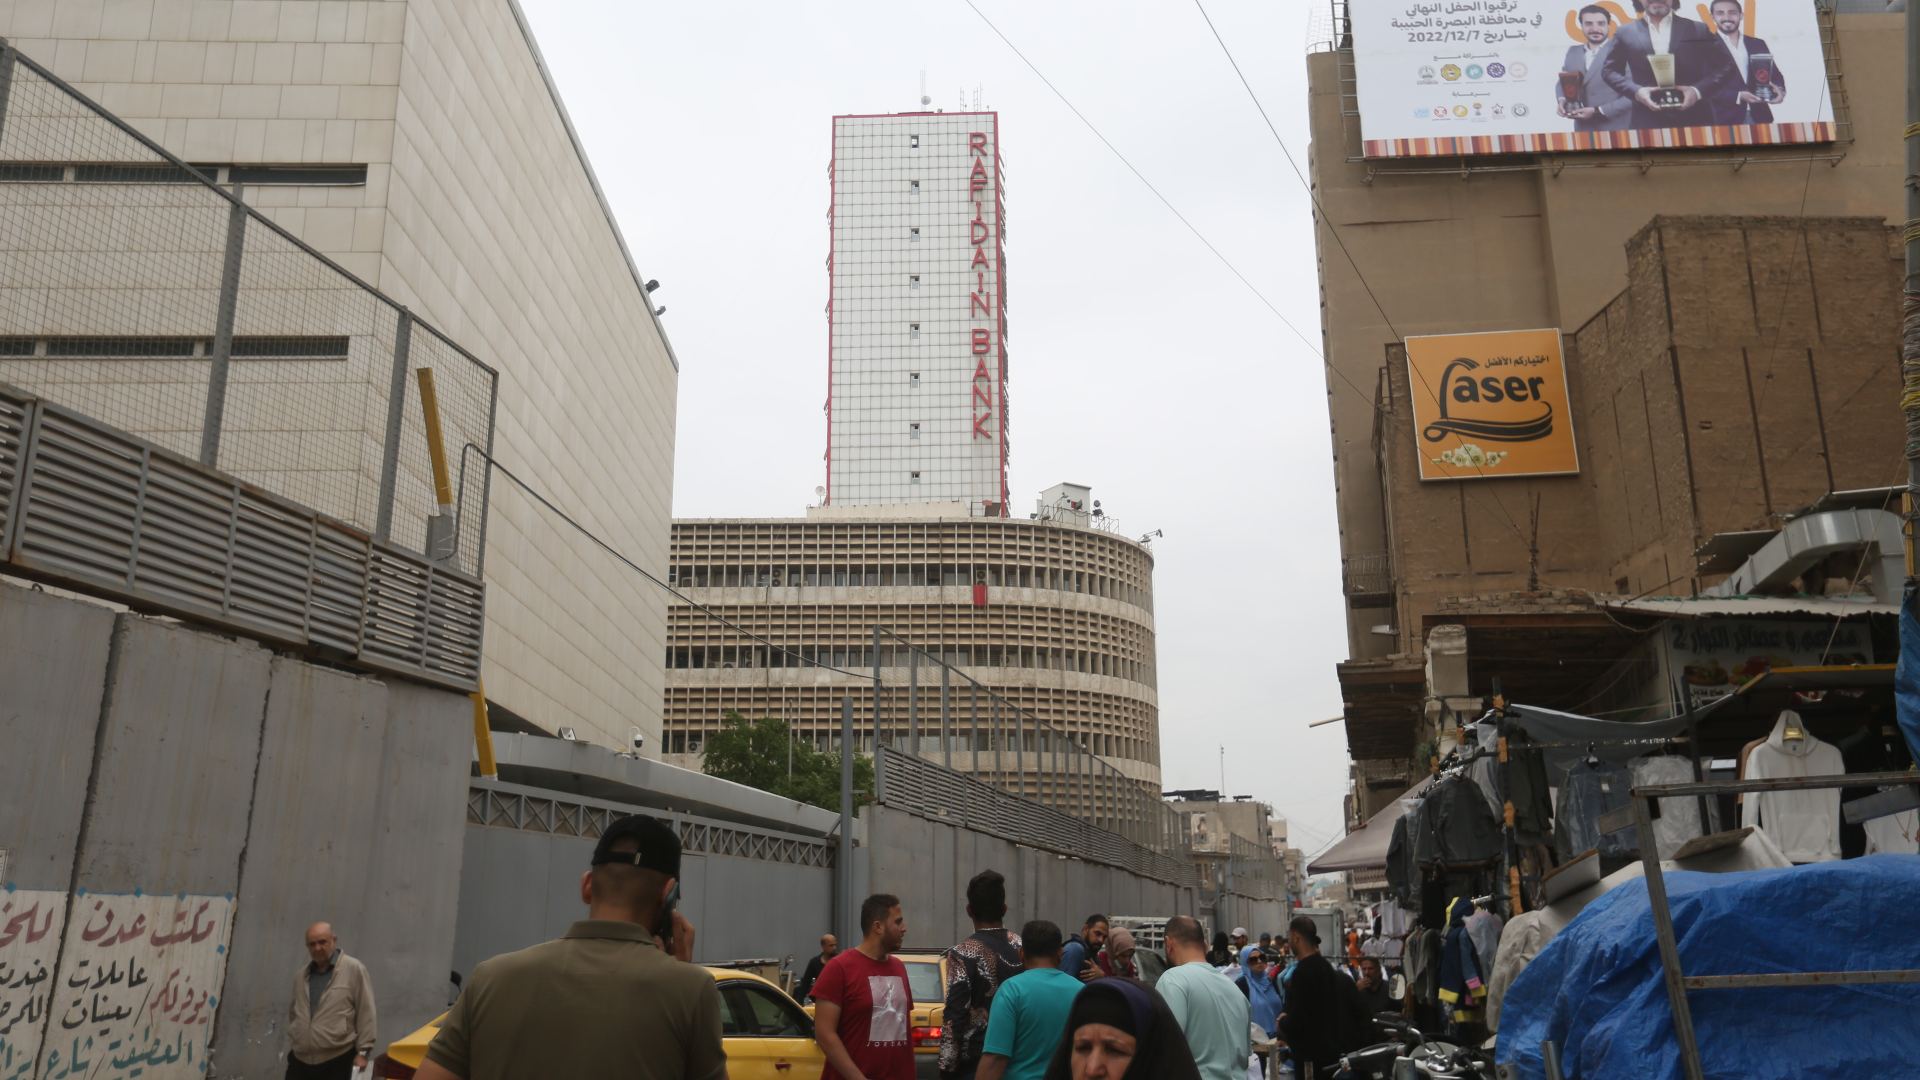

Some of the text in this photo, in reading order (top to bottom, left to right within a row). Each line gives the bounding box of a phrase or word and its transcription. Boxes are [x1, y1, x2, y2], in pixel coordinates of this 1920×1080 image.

[1391, 12, 1543, 31] في محافظة البصرة الحبيبة
[1406, 3, 1442, 18] النهائي
[1445, 1, 1480, 14] الحفل
[1408, 31, 1480, 43] 2022/12/7
[969, 132, 992, 440] RAFIDAIN BANK
[1513, 355, 1549, 367] اختياركم
[81, 901, 147, 947] عدن
[150, 901, 216, 958] مكتب
[68, 955, 148, 989] عاملات
[150, 968, 208, 1025] يوفر لكم
[61, 992, 133, 1036] معينات
